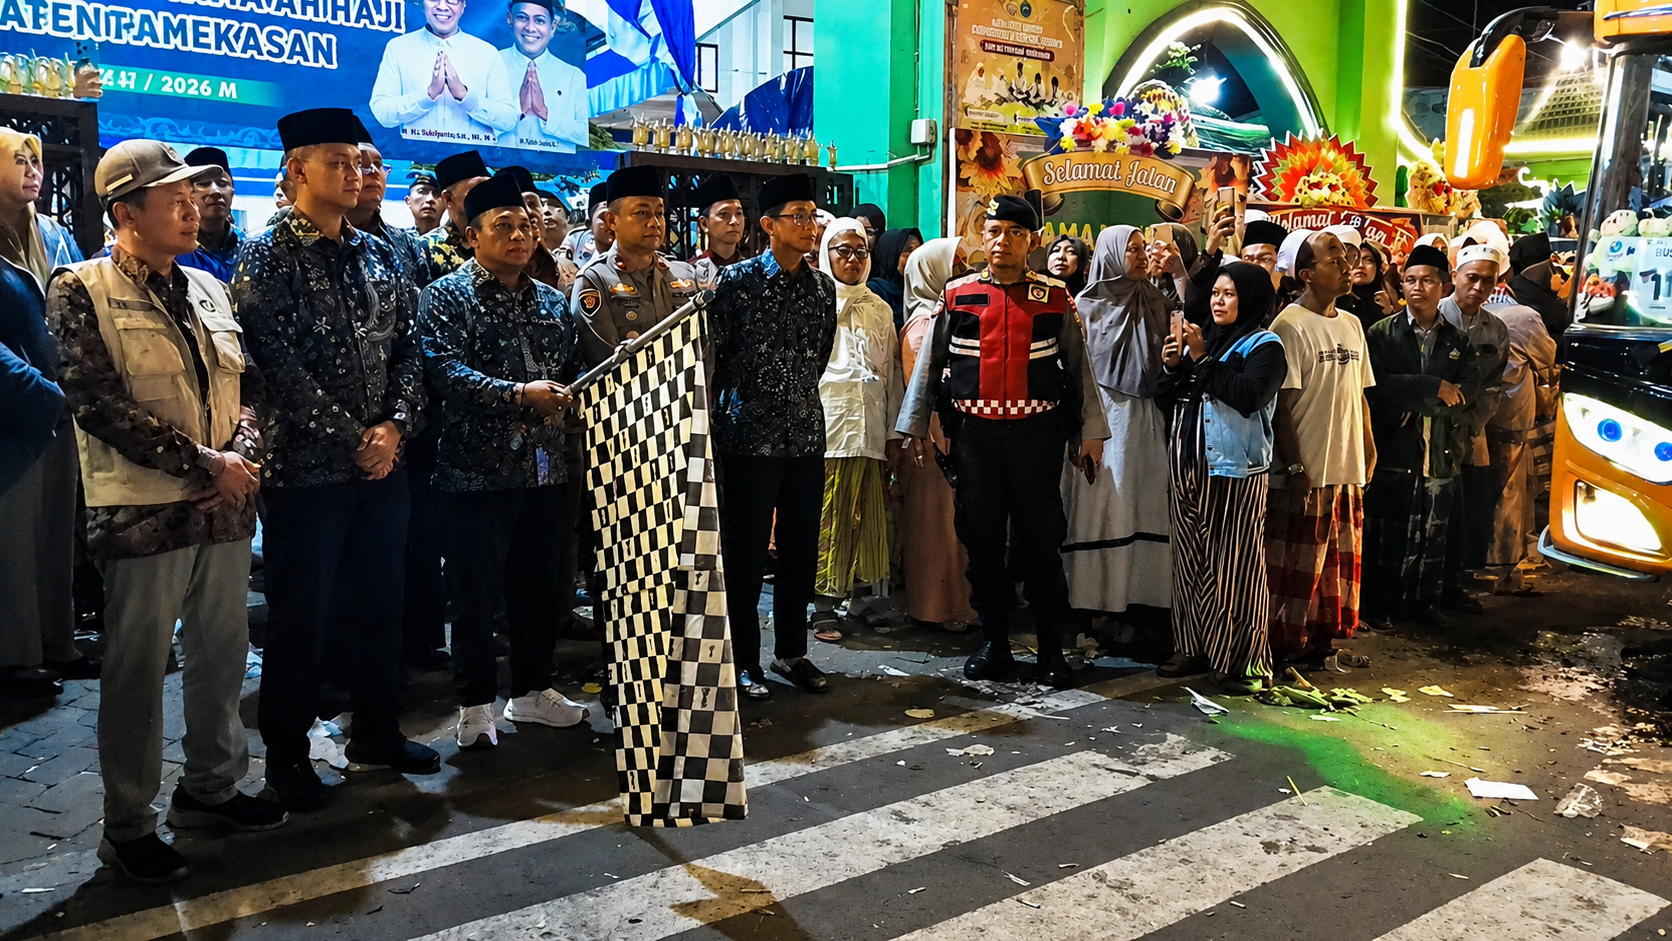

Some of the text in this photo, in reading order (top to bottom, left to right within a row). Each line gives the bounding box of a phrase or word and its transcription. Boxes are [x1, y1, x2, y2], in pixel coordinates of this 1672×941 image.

[330, 0, 404, 31] HAJI
[161, 75, 212, 96] 2026
[218, 81, 237, 99] M
[1043, 159, 1177, 194] Selamat Jalan
